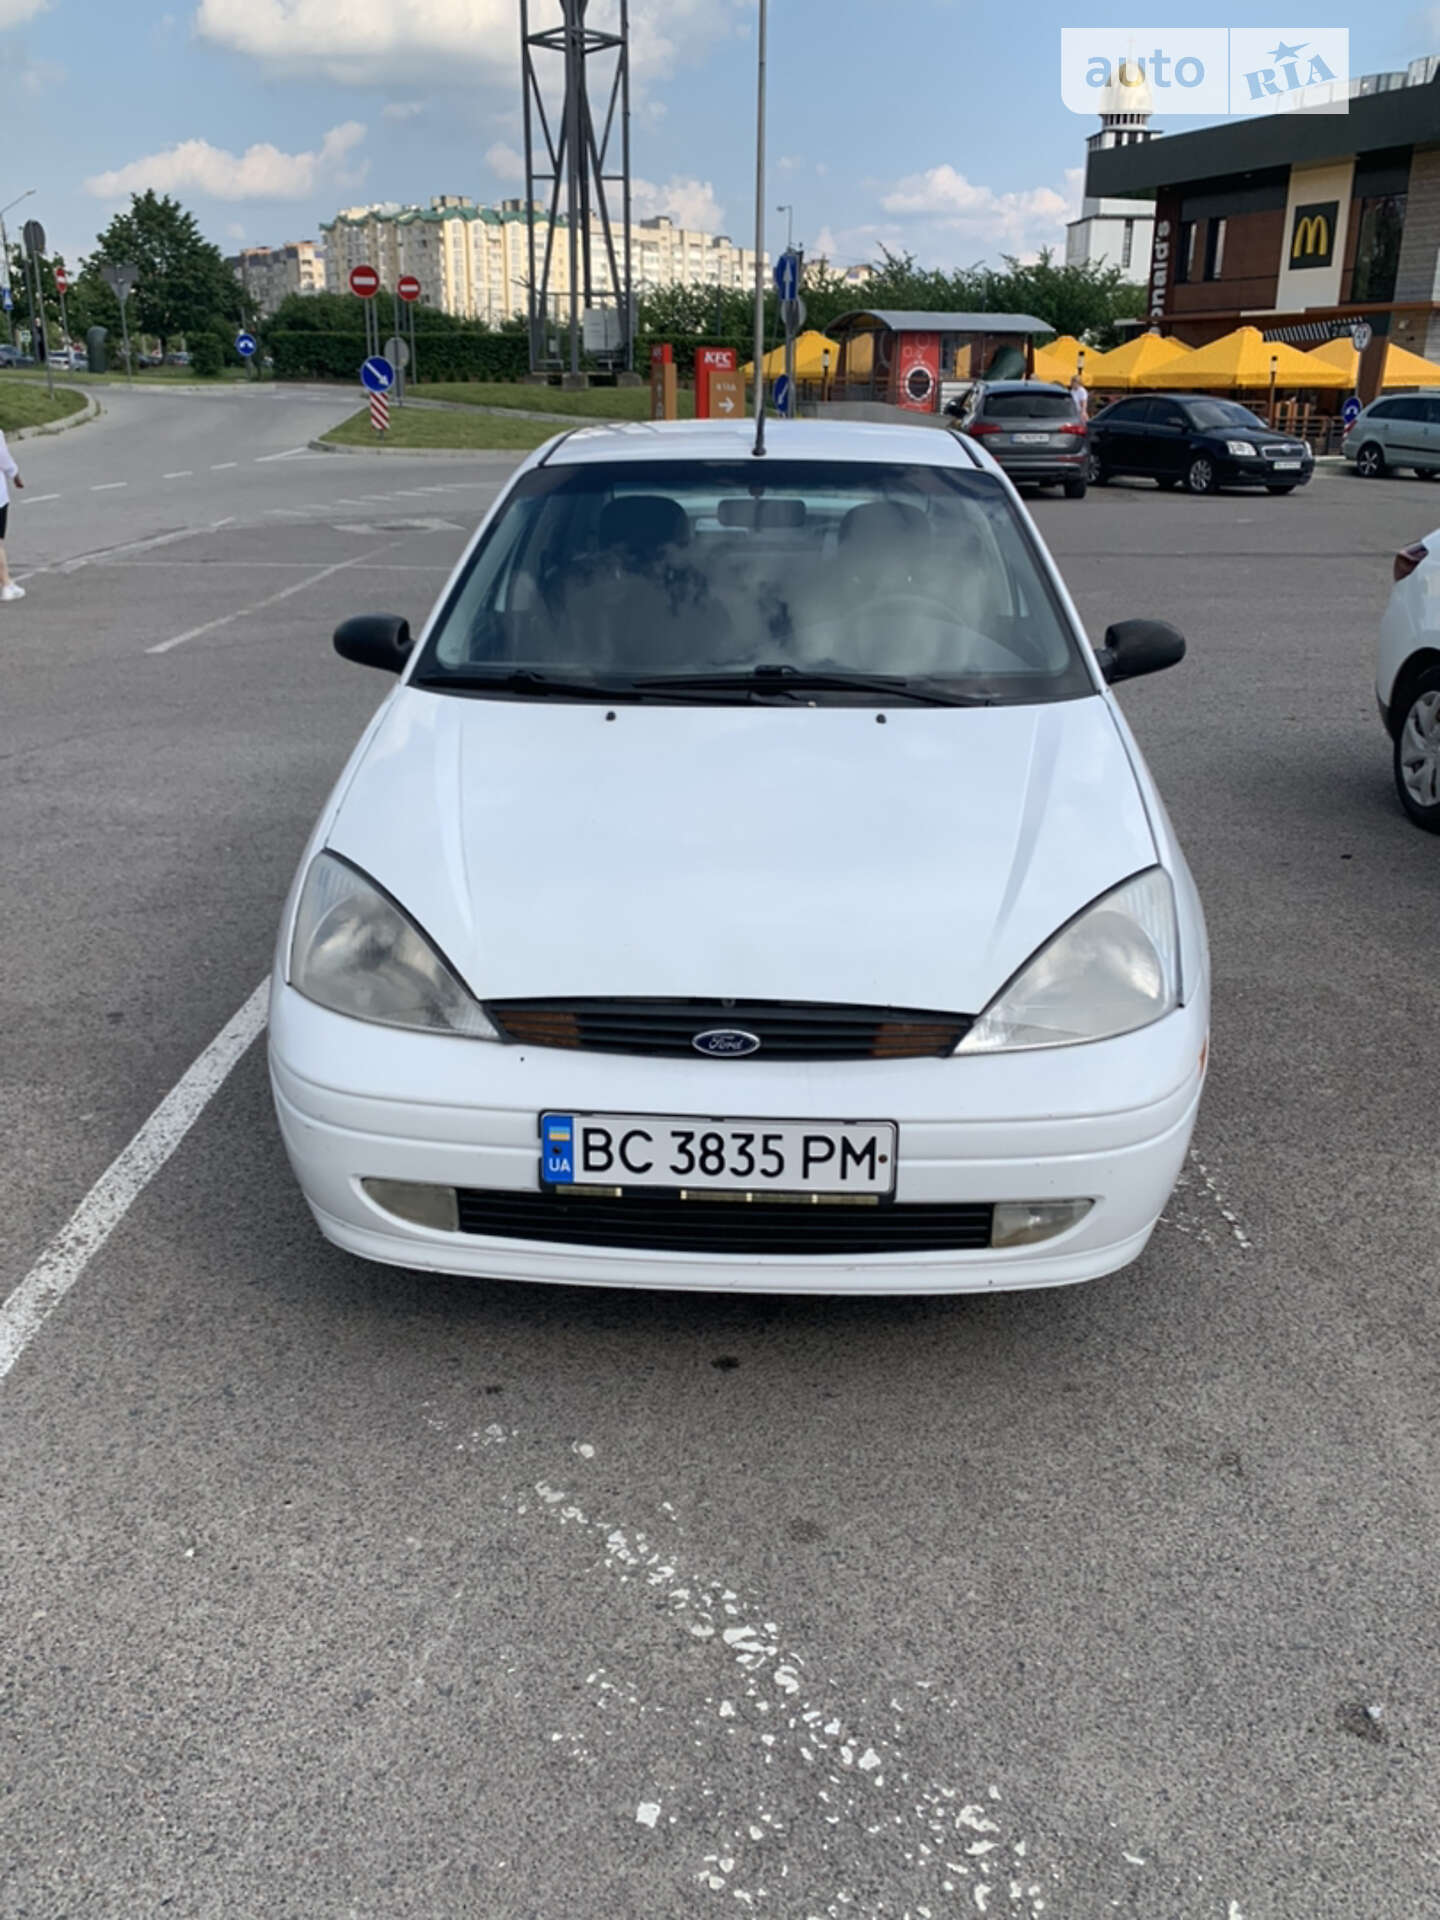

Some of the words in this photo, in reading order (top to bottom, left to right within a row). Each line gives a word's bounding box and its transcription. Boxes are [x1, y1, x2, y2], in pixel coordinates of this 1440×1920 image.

[1148, 220, 1171, 334] onald's
[708, 1034, 744, 1050] Ford
[549, 1158, 571, 1173] UA
[582, 1127, 654, 1175] BC
[669, 1130, 785, 1178] 3835
[802, 1135, 877, 1181] PM
